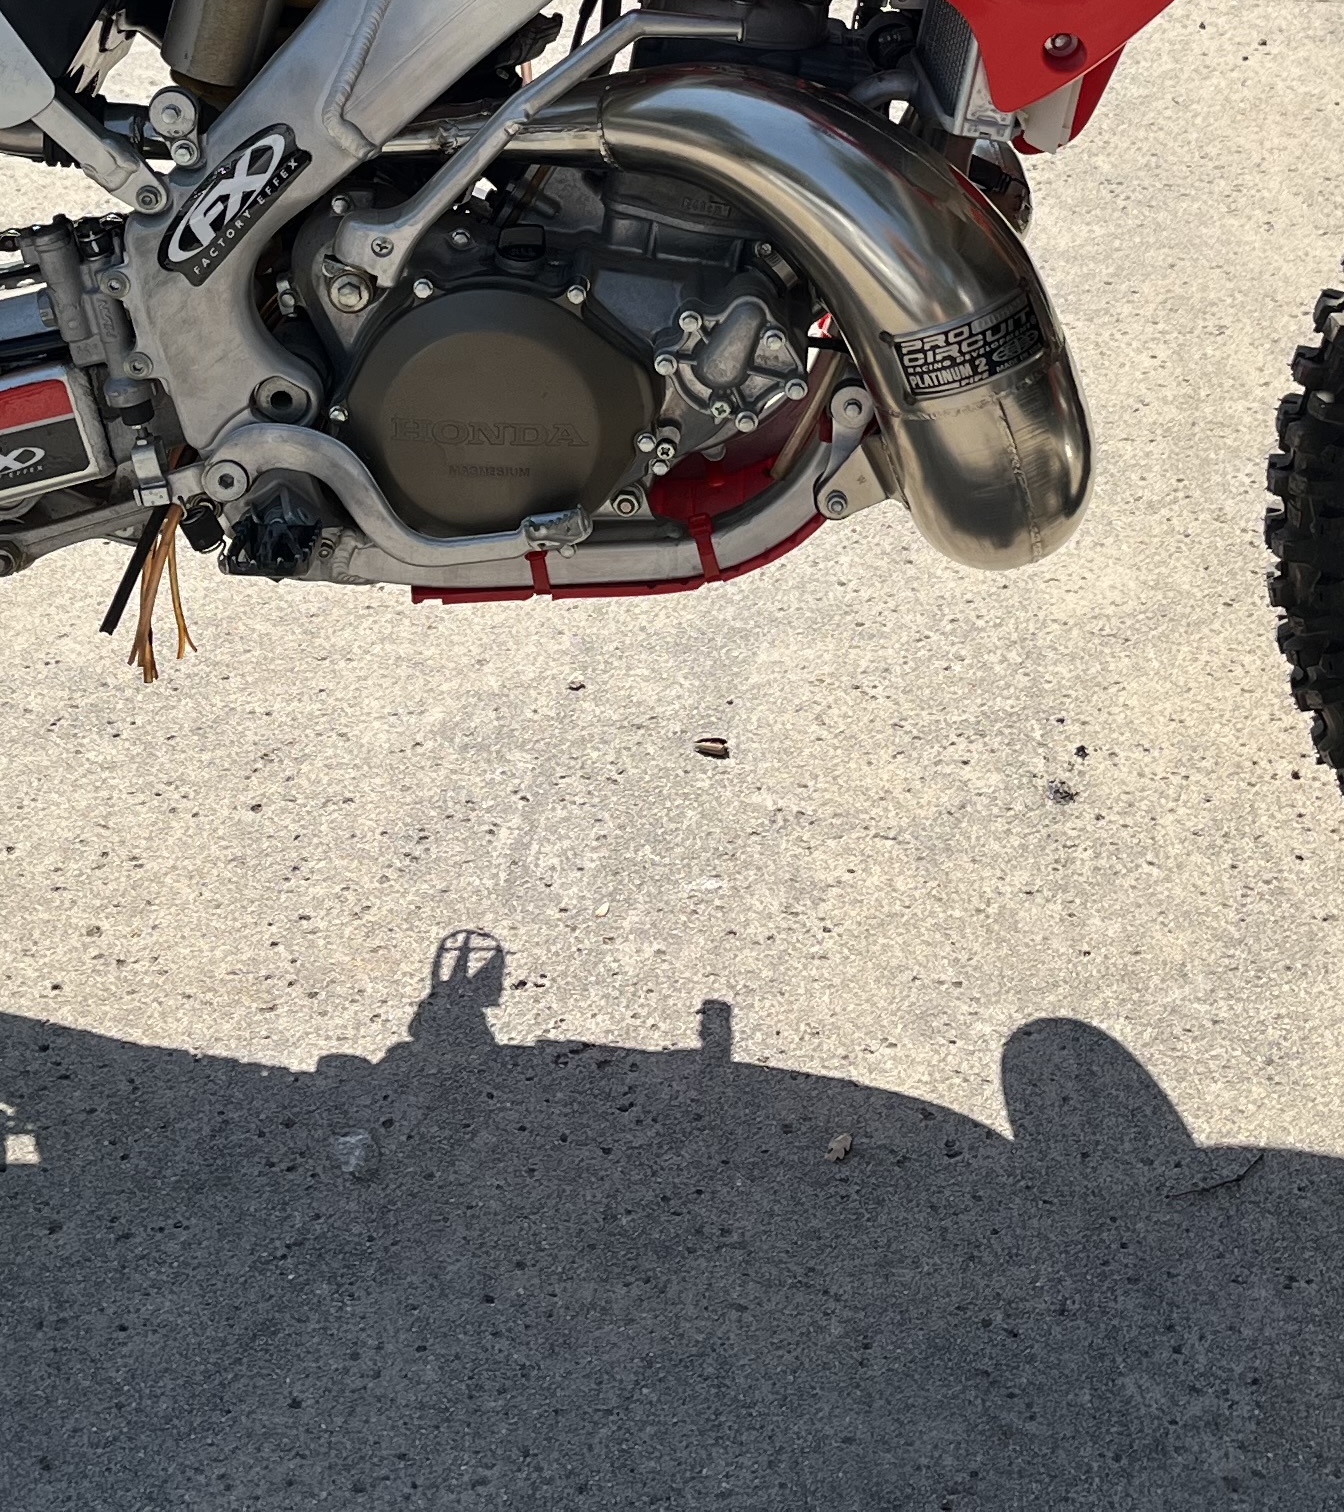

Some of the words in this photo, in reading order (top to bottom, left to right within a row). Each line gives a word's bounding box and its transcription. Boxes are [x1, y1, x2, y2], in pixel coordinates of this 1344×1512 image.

[188, 143, 274, 247] FX
[193, 209, 253, 276] FACTORY
[256, 157, 299, 206] EFFEX
[900, 324, 970, 355] PRO
[903, 307, 1031, 367] CIRCUIT
[907, 359, 952, 374] RACING
[955, 324, 1031, 363] DEVELOPMENT
[909, 363, 973, 389] PLATINUM
[974, 356, 989, 373] 2
[960, 371, 990, 387] PIPE
[391, 416, 589, 448] HONDA
[8, 464, 44, 479] EFFEX
[448, 464, 531, 479] MAGNESIUM
